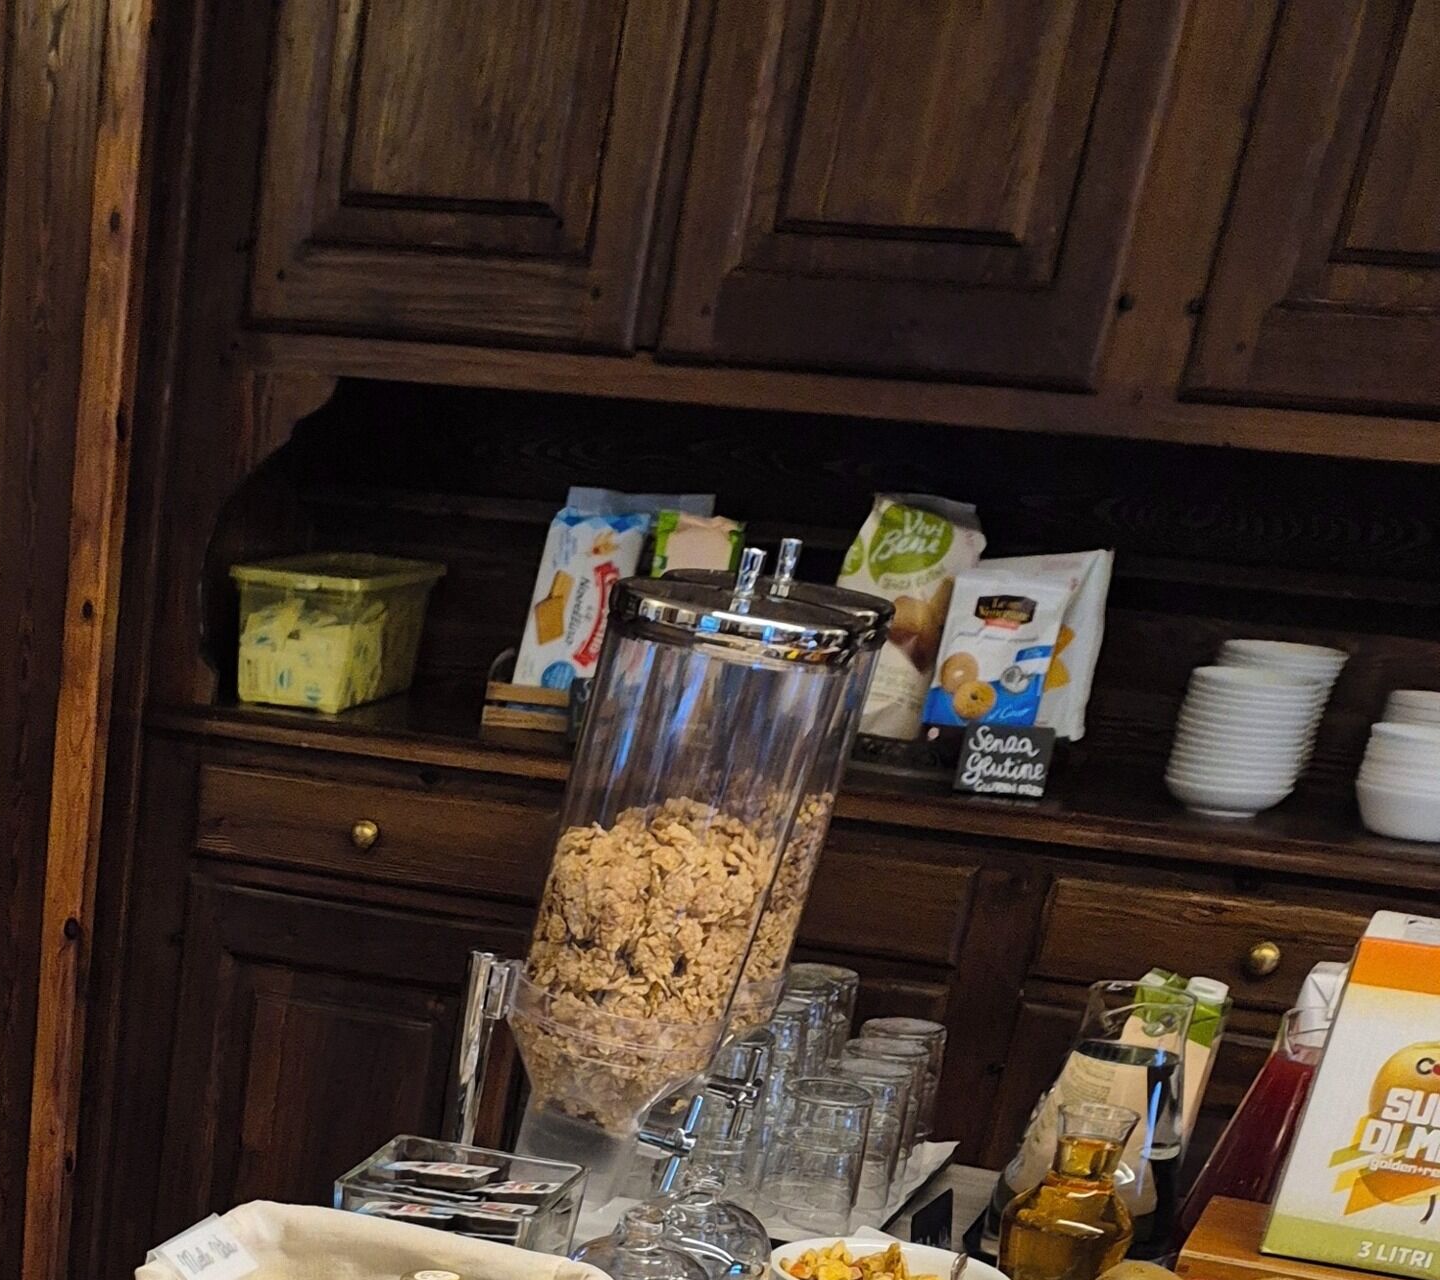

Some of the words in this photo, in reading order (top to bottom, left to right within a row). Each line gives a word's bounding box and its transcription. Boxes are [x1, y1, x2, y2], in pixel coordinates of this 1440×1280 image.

[969, 725, 1040, 757] Senza
[1381, 1087, 1440, 1128] SU
[1358, 1118, 1404, 1155] DI
[1405, 1126, 1440, 1163] M
[1358, 1241, 1373, 1258] 3
[1375, 1244, 1433, 1269] LITRI
